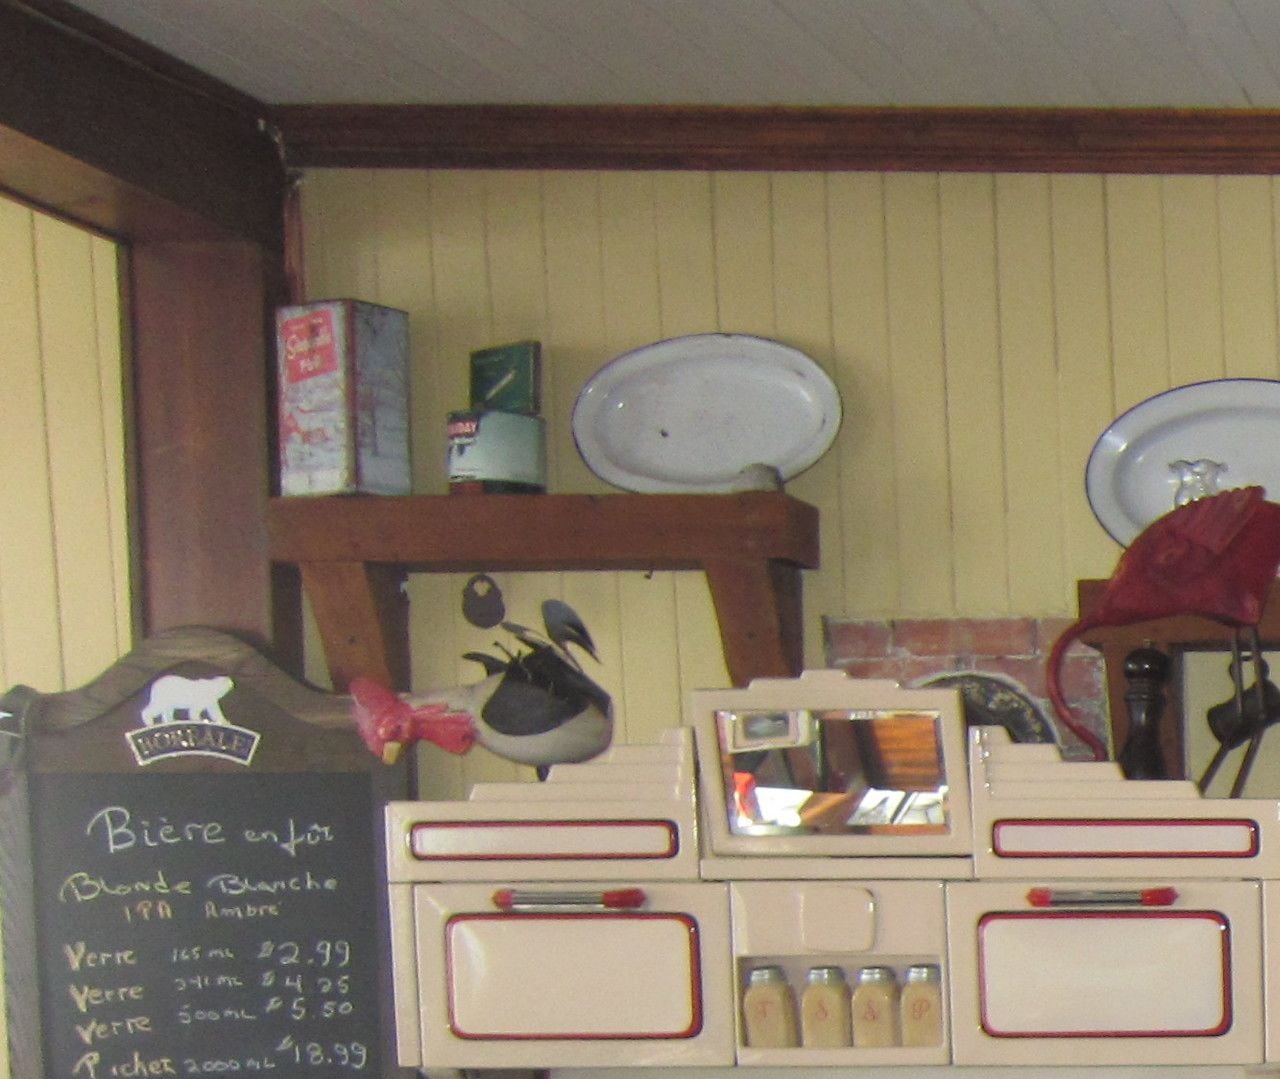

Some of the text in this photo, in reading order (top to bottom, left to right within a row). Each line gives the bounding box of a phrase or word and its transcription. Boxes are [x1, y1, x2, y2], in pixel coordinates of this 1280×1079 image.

[86, 805, 226, 854] Bière
[60, 870, 339, 902] Blonde Blanche
[65, 941, 138, 971] Verre
[257, 939, 351, 968] $2.99
[69, 983, 145, 1013] Verre
[76, 1015, 151, 1045] Verre
